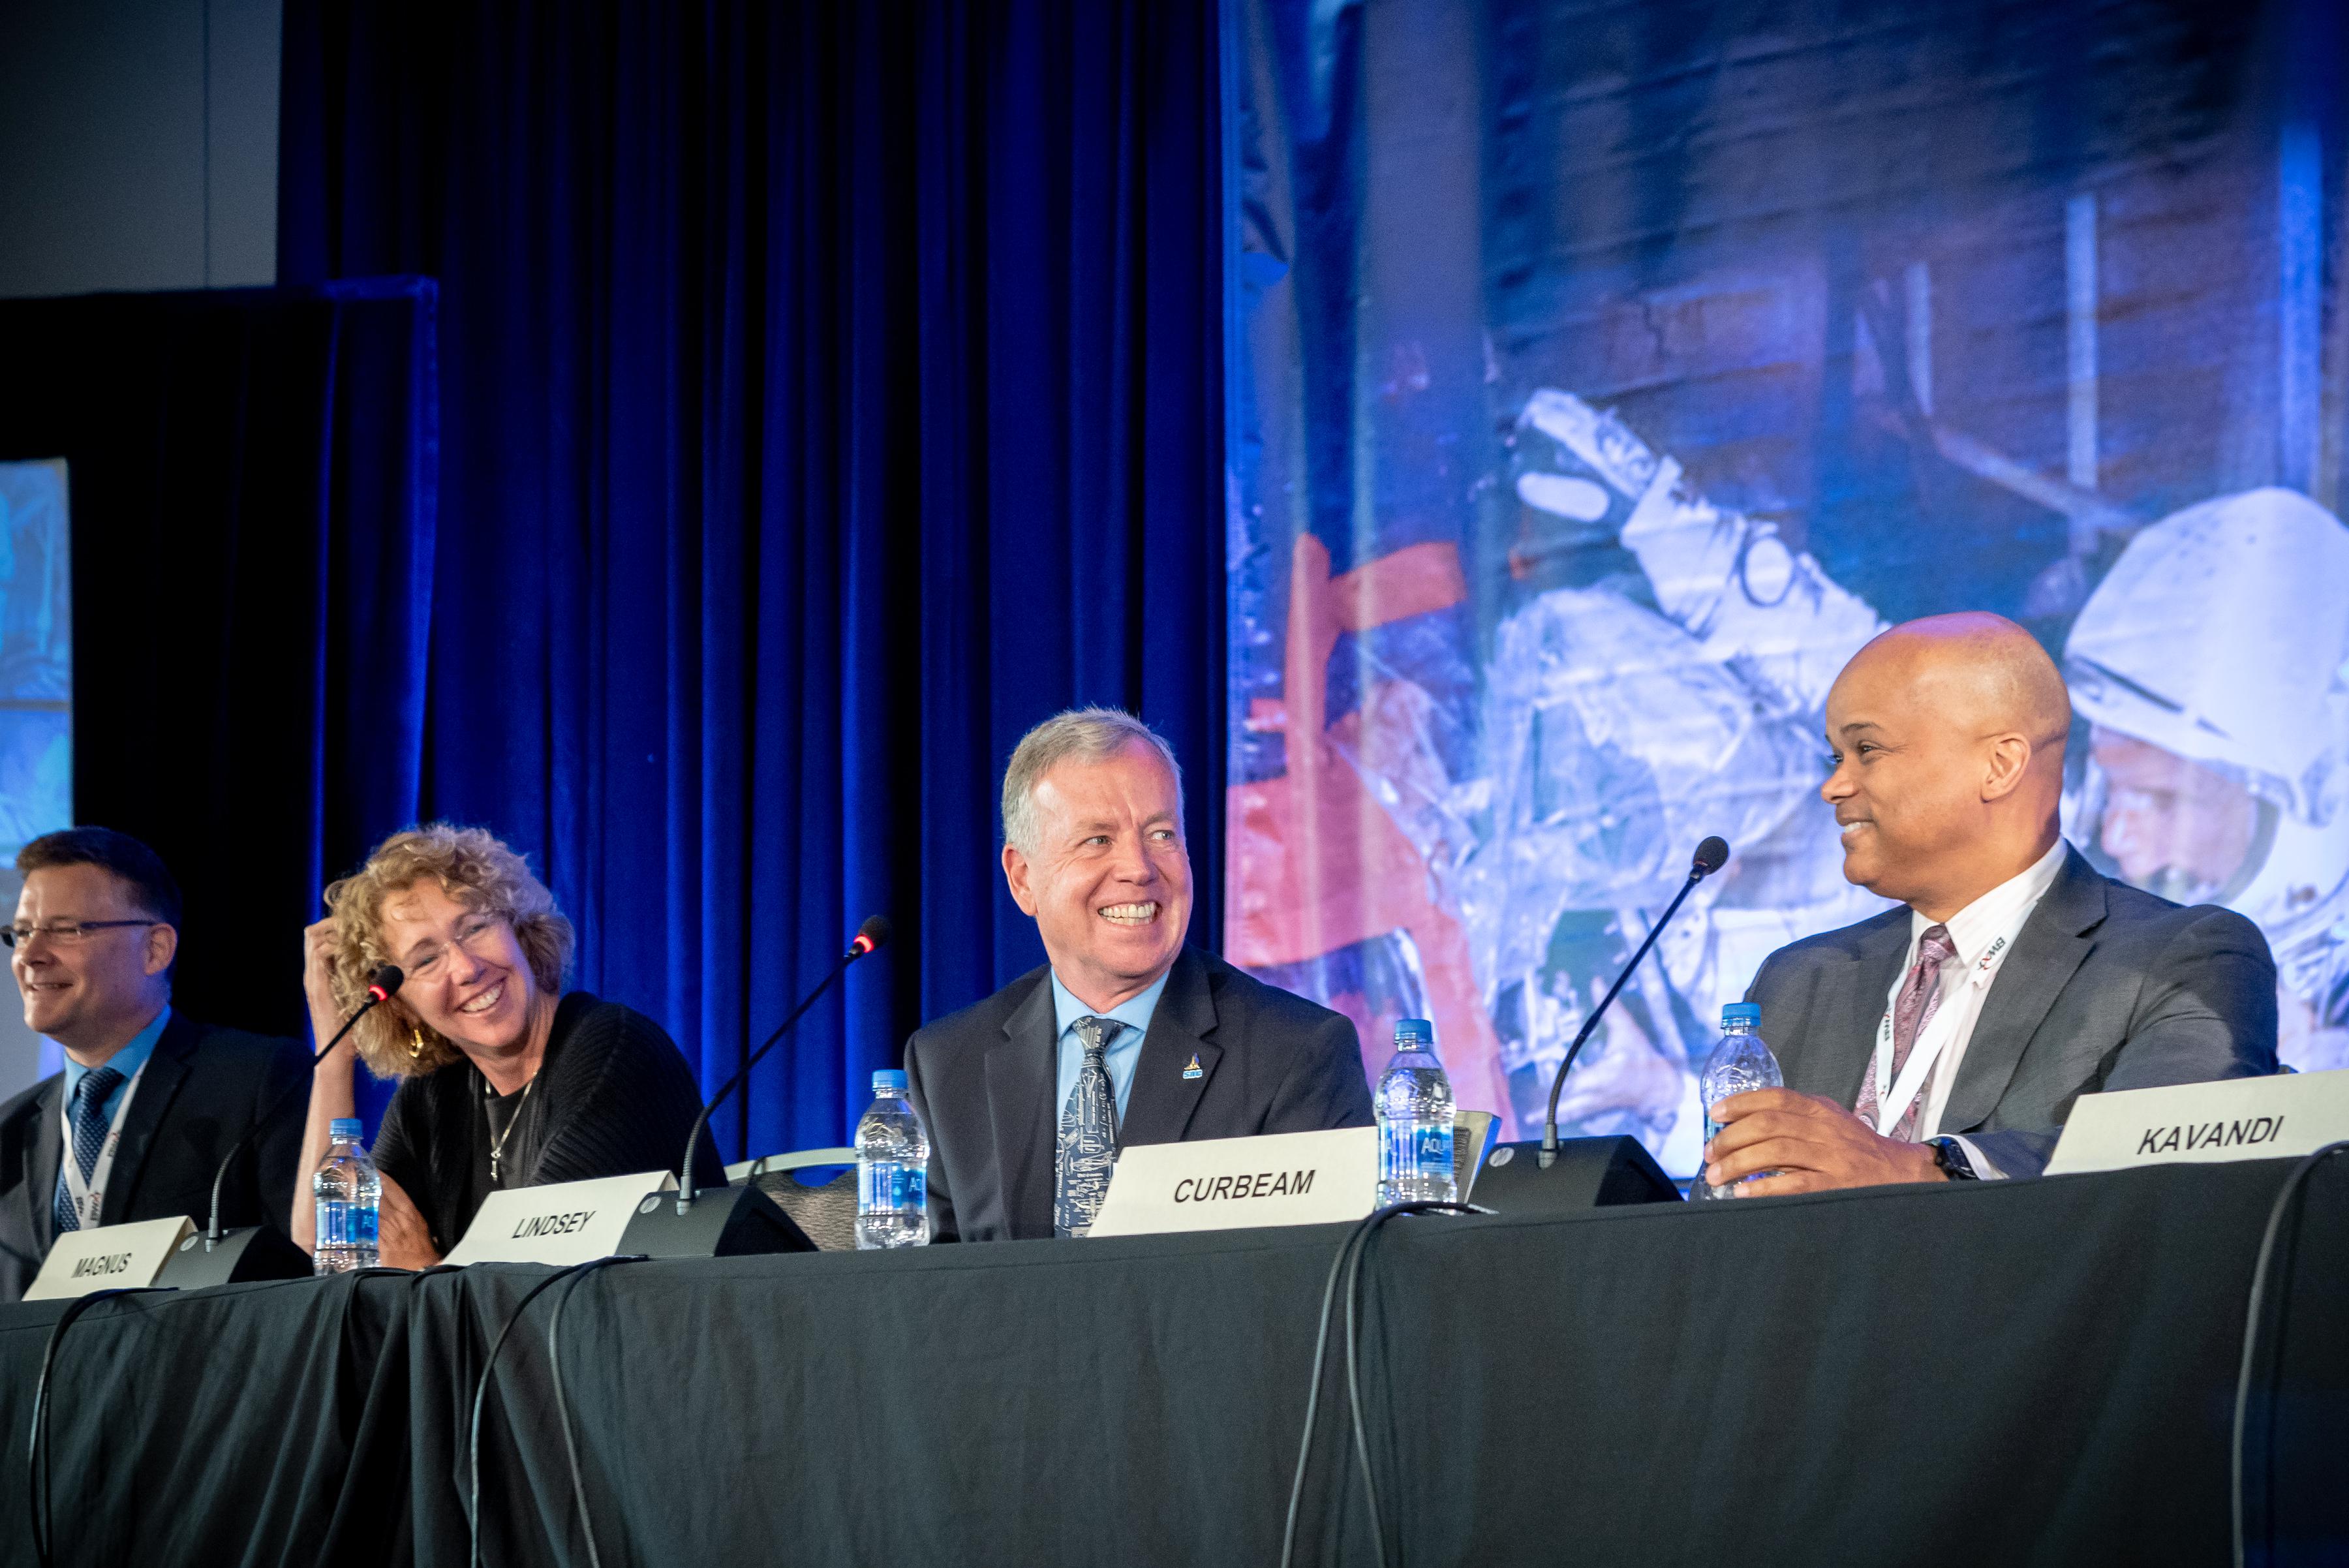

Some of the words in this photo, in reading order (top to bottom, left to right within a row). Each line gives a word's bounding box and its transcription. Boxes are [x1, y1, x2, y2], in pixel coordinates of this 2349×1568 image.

[2137, 1115, 2284, 1154] KAVANDI
[1174, 1169, 1315, 1203] CURBEAM
[512, 1210, 596, 1238] LINDSEY
[70, 1252, 132, 1278] MAGNUS
